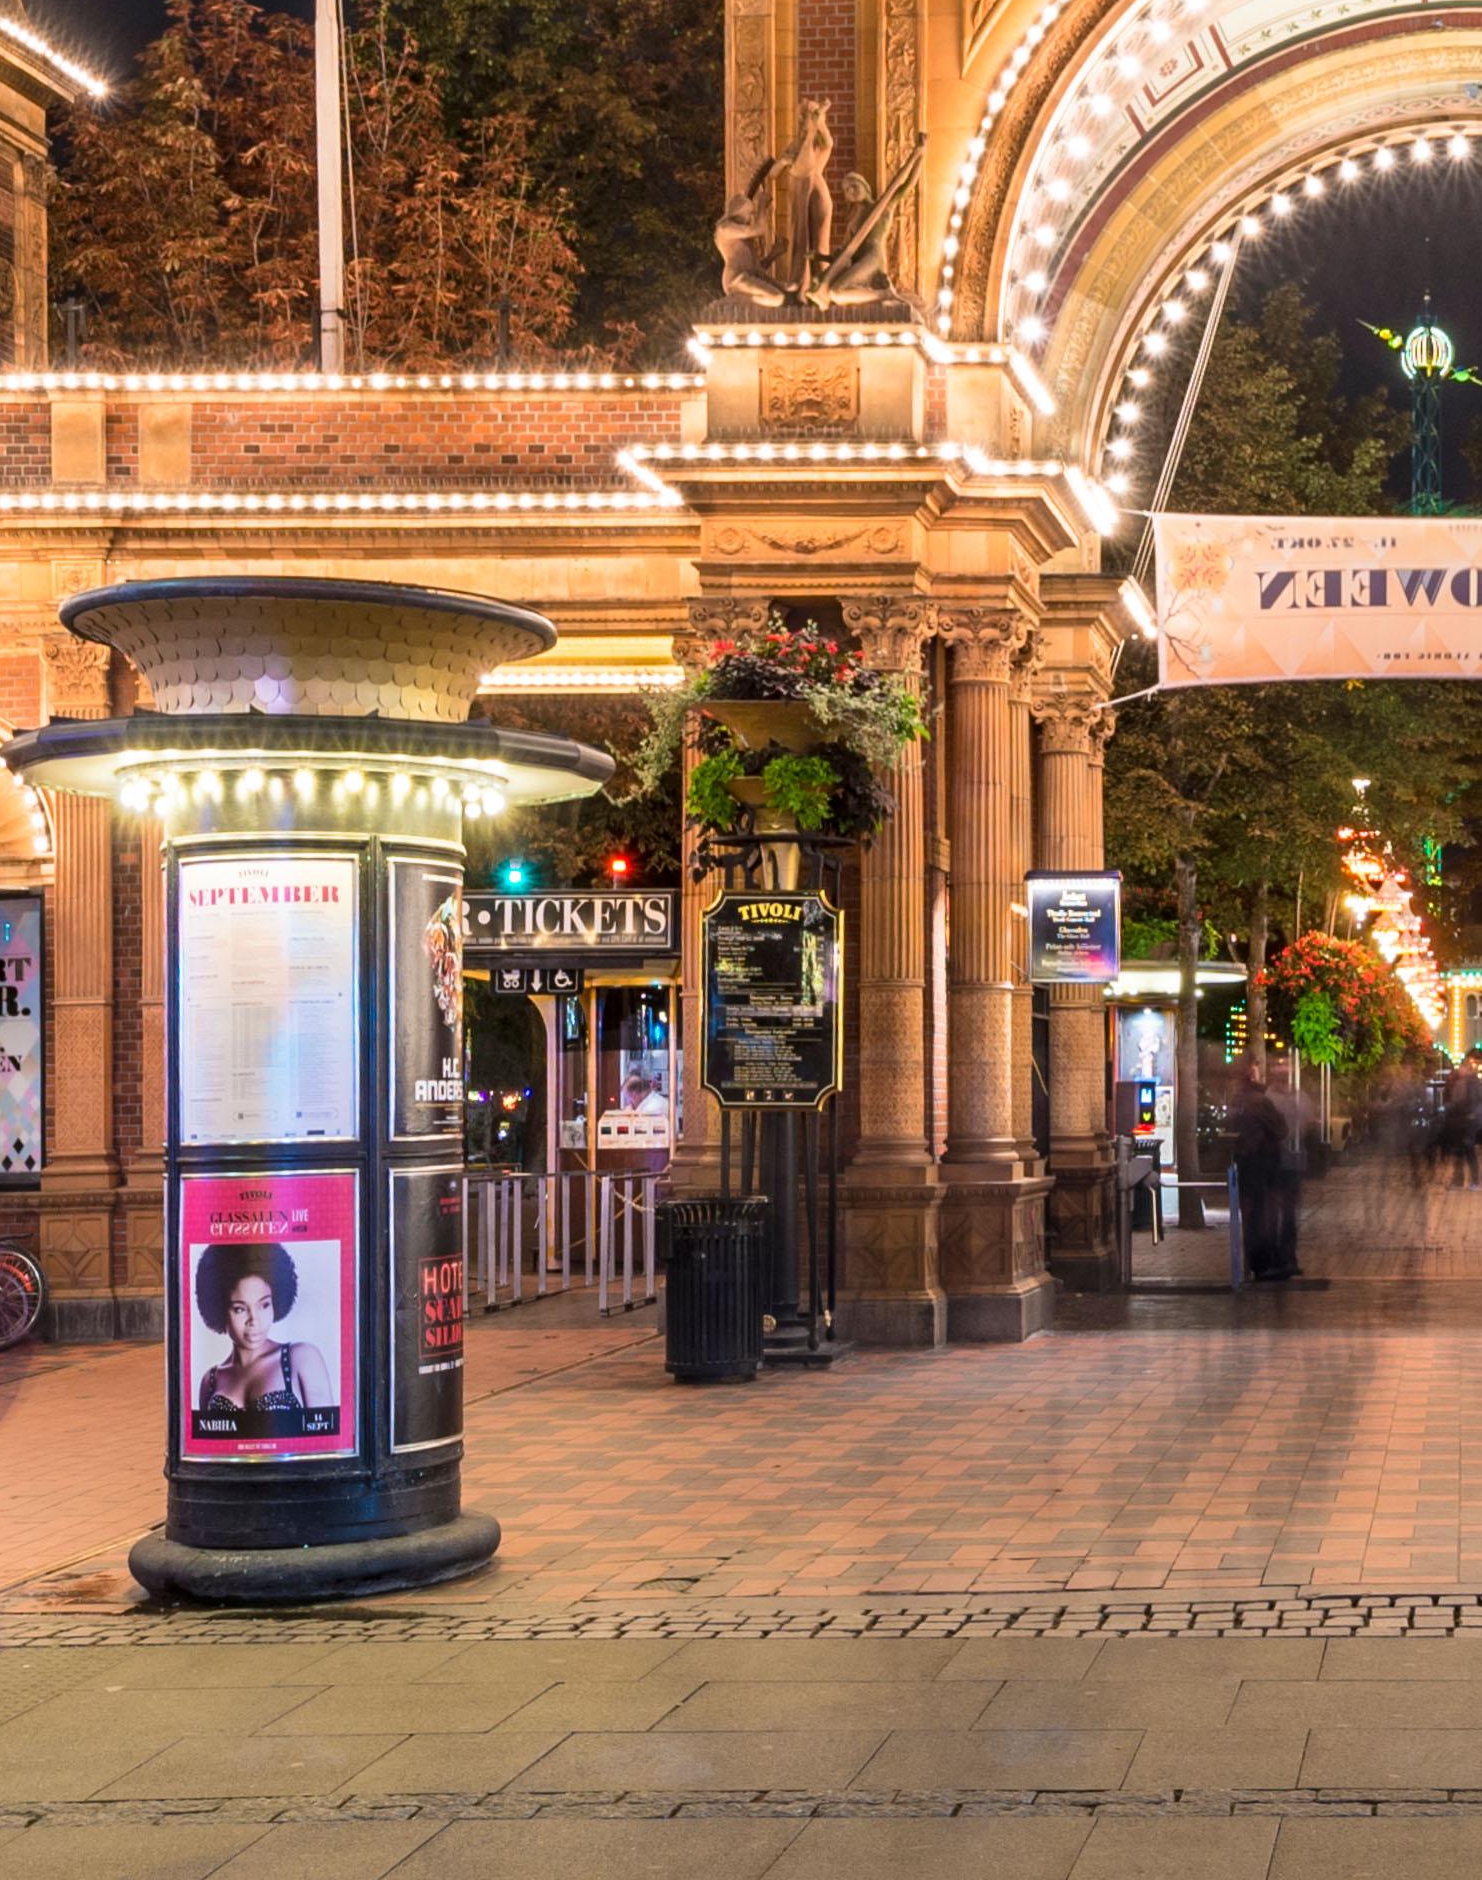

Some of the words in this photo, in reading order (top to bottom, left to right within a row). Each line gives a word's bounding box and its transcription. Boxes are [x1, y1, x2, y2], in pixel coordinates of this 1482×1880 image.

[189, 885, 339, 907] SEPTEMBER
[494, 898, 667, 935] TICKETS
[738, 902, 802, 921] TIVOLI
[239, 1190, 272, 1201] TIVOLI
[292, 1208, 309, 1222] LIVE
[199, 1419, 237, 1432] NABIHA
[307, 1421, 329, 1431] SEPT
